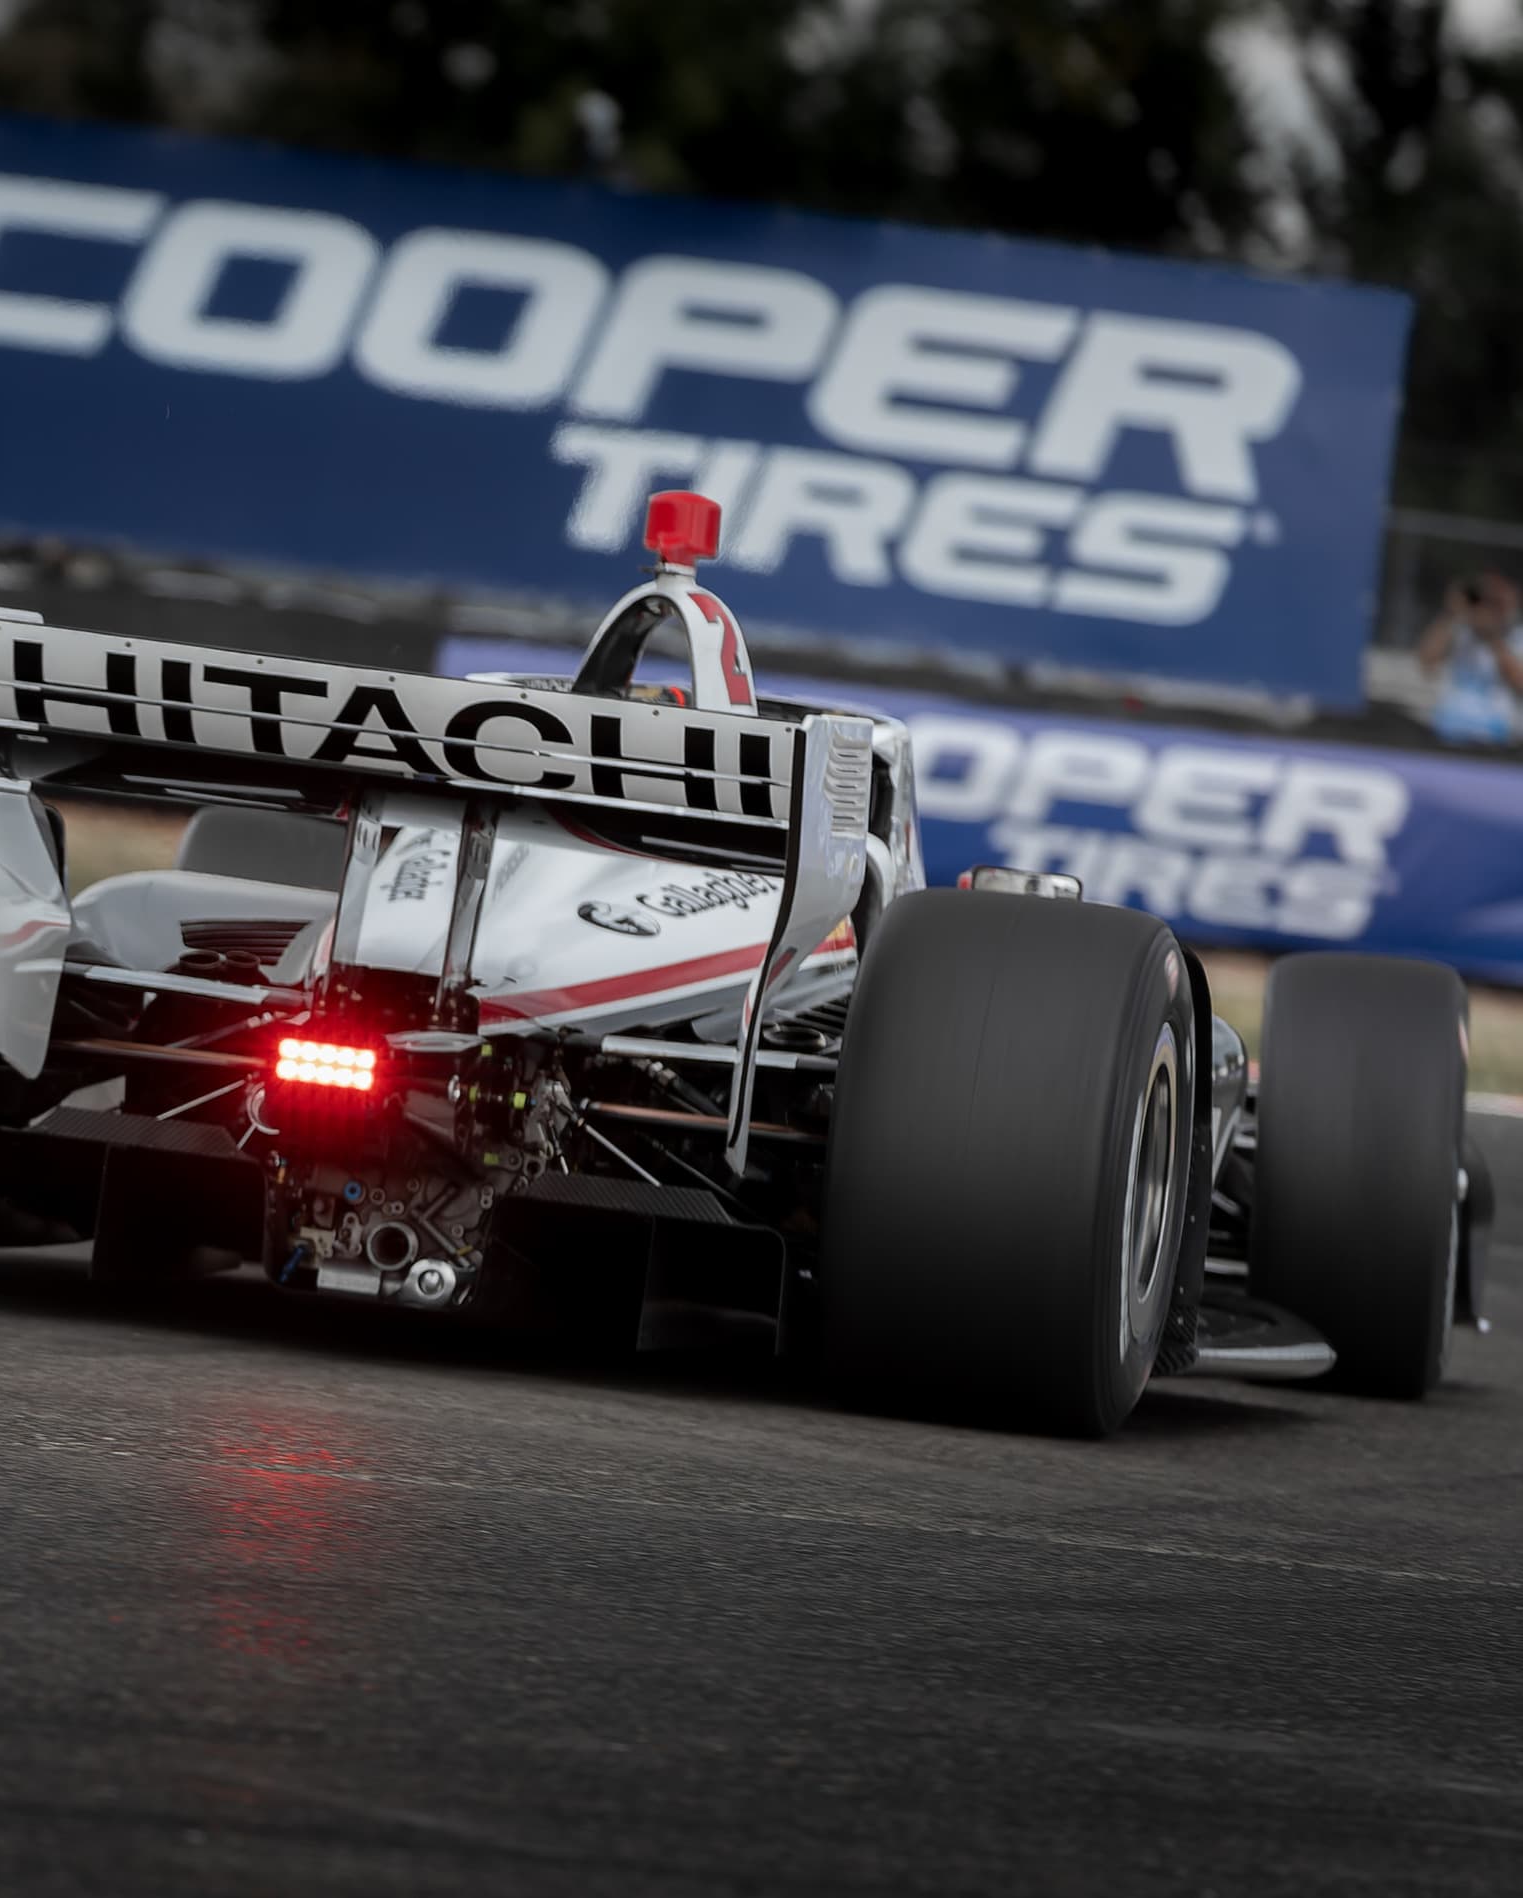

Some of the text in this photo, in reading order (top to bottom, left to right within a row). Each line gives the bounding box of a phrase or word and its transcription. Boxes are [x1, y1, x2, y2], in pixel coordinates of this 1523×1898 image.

[549, 421, 1253, 627] TIRES
[12, 639, 772, 817] HITACHI
[688, 592, 753, 706] 2
